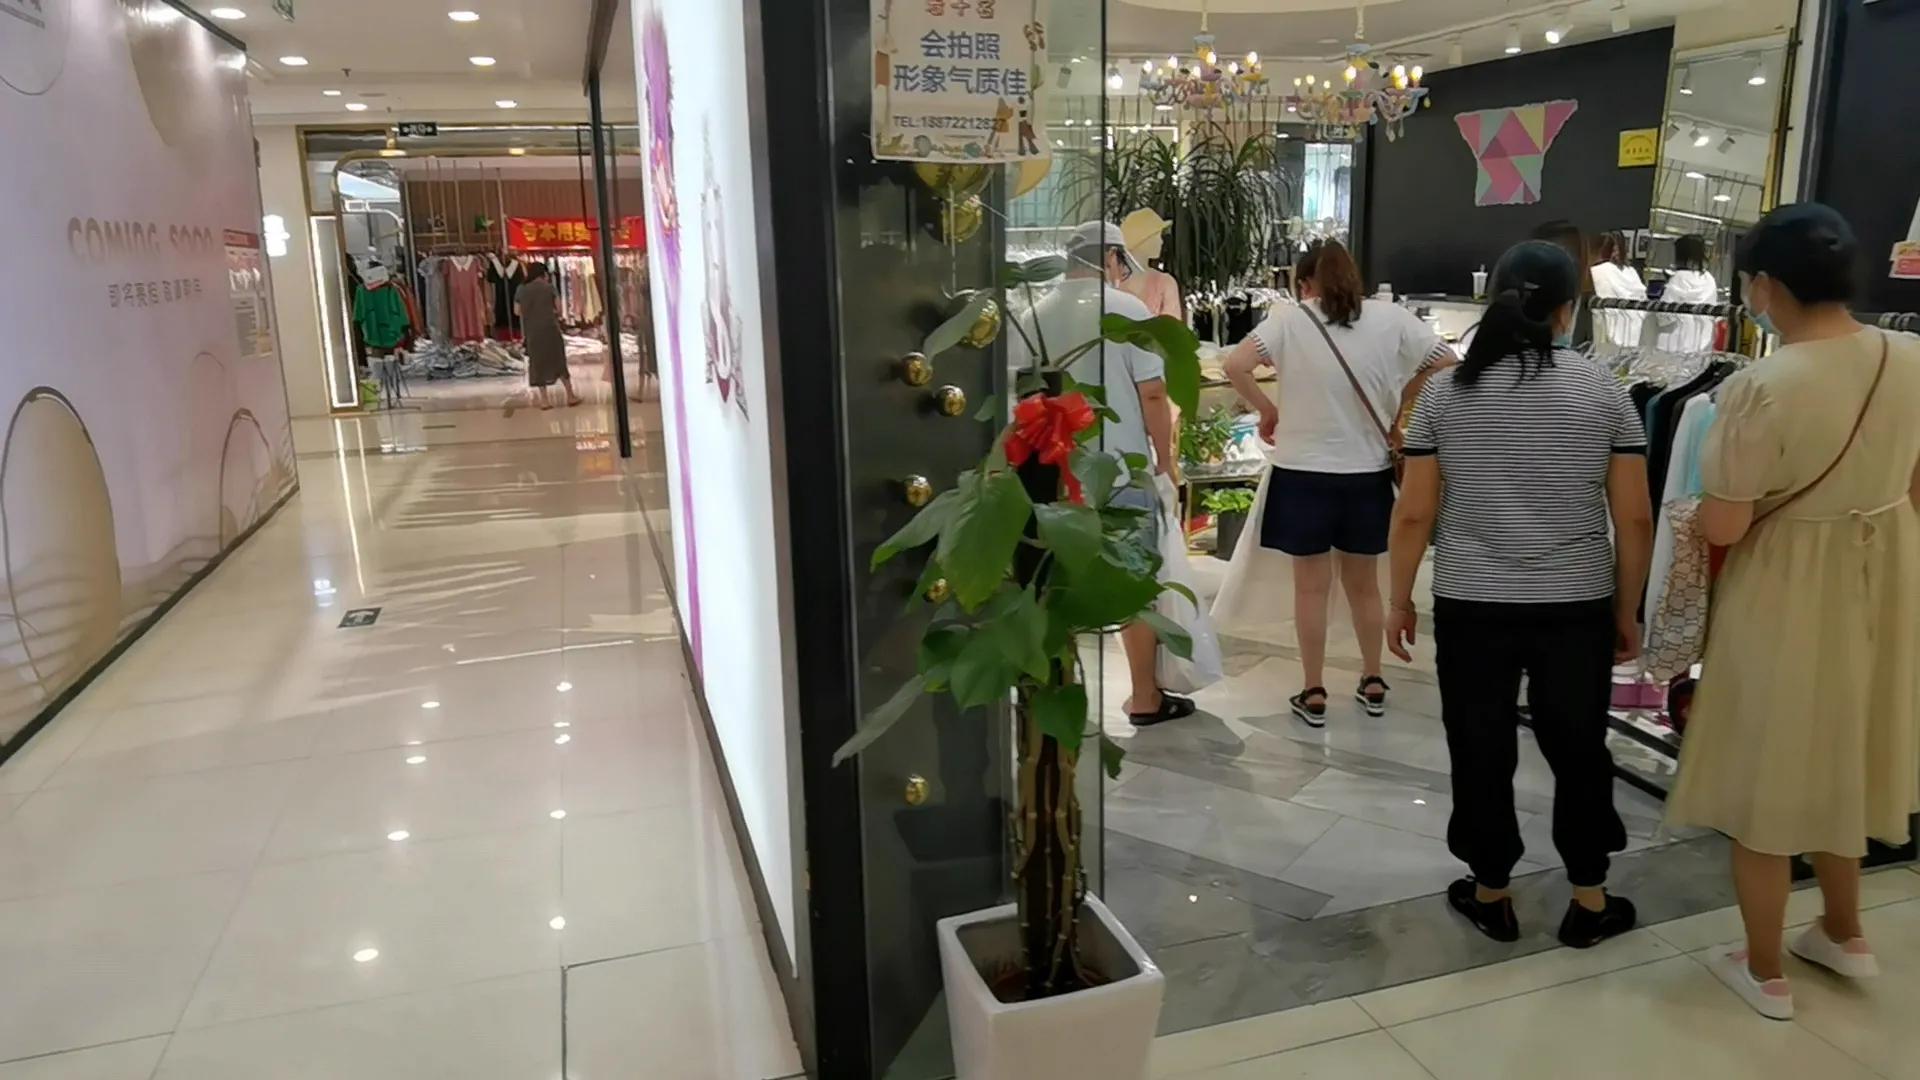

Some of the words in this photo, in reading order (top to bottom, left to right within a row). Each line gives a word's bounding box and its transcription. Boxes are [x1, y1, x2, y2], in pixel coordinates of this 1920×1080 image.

[921, 29, 1000, 60] 会拍照
[894, 64, 1027, 96] 形象气质佳
